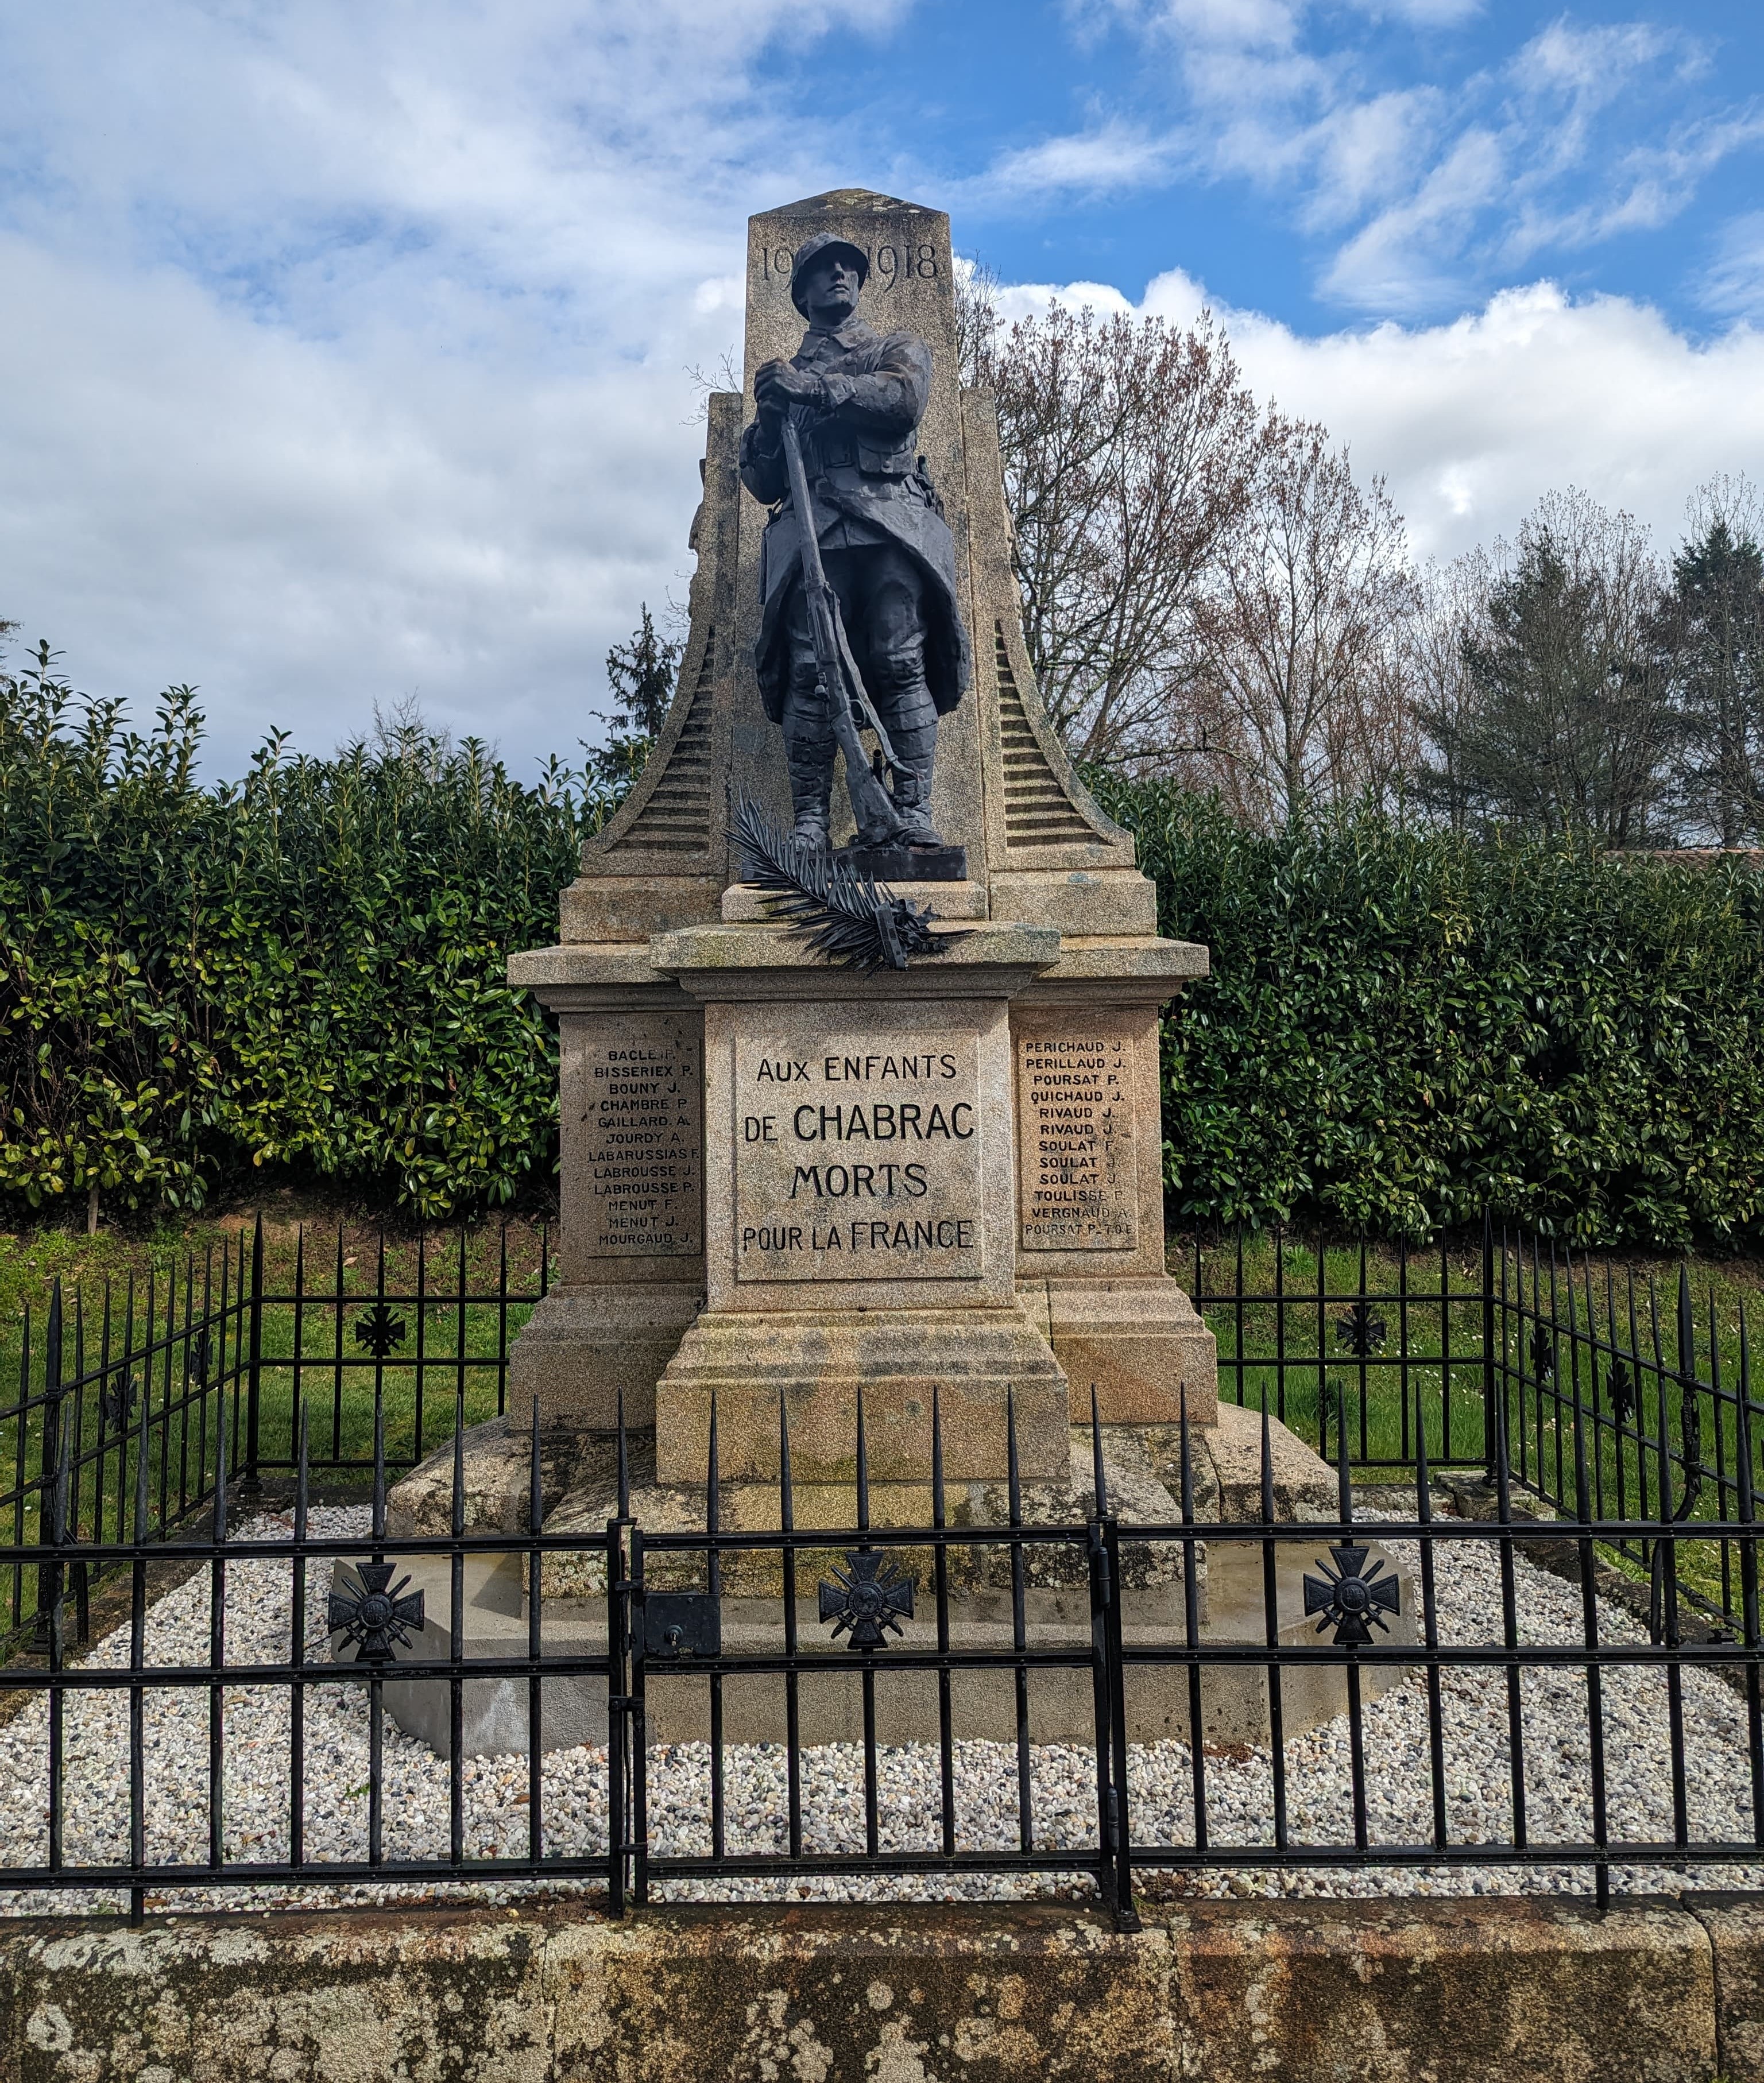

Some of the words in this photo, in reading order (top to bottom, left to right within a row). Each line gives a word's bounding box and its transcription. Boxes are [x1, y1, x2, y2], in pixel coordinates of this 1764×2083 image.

[1026, 1042, 1104, 1052] PERICHAUD
[1112, 1041, 1126, 1052] J.
[609, 1050, 656, 1060] BACLE
[757, 1058, 811, 1082] AUX
[825, 1054, 957, 1081] ENFANTS
[1026, 1058, 1105, 1069] PERILLAUD
[1113, 1058, 1126, 1068] J.
[594, 1066, 673, 1078] BISSERIEX
[682, 1066, 693, 1077] P.
[1034, 1075, 1099, 1086] POURSAT
[1108, 1075, 1119, 1085] P.
[609, 1083, 659, 1094] BOUNY
[667, 1082, 680, 1093] J.
[1031, 1091, 1103, 1104] QUICHAUD
[1112, 1091, 1125, 1102] J.
[601, 1099, 670, 1112] CHAMBRE
[1039, 1108, 1093, 1118] RIVAUD
[1102, 1108, 1115, 1118] J.
[676, 1116, 690, 1126] A.
[745, 1116, 778, 1142] DE
[794, 1102, 974, 1141] CHABRAC
[1040, 1124, 1094, 1135] RIVAUD
[606, 1133, 663, 1144] JOURDY
[671, 1132, 684, 1143] A.
[1039, 1140, 1096, 1152] SOULAT
[589, 1148, 687, 1161] LABARUSSIAS
[691, 1148, 699, 1159] F.
[1039, 1157, 1097, 1168] SOULAT
[594, 1166, 676, 1179] LABROUSSE
[683, 1165, 695, 1175] J.
[789, 1163, 928, 1199] MORTS
[1039, 1174, 1099, 1184] SOULAT
[594, 1182, 678, 1195] LABROUSSE
[683, 1182, 695, 1193] P.
[1034, 1190, 1107, 1201] TOULISSE
[609, 1200, 657, 1211] MENUT
[665, 1199, 678, 1210] F.
[1032, 1207, 1110, 1218] VERGNAUD
[609, 1217, 659, 1228] MENUT
[666, 1215, 679, 1226] J.
[599, 1233, 672, 1245] MOURGAUD
[680, 1232, 693, 1243] J.
[743, 1227, 802, 1252] POUR
[812, 1226, 841, 1250] LA
[852, 1219, 974, 1250] FRANCE
